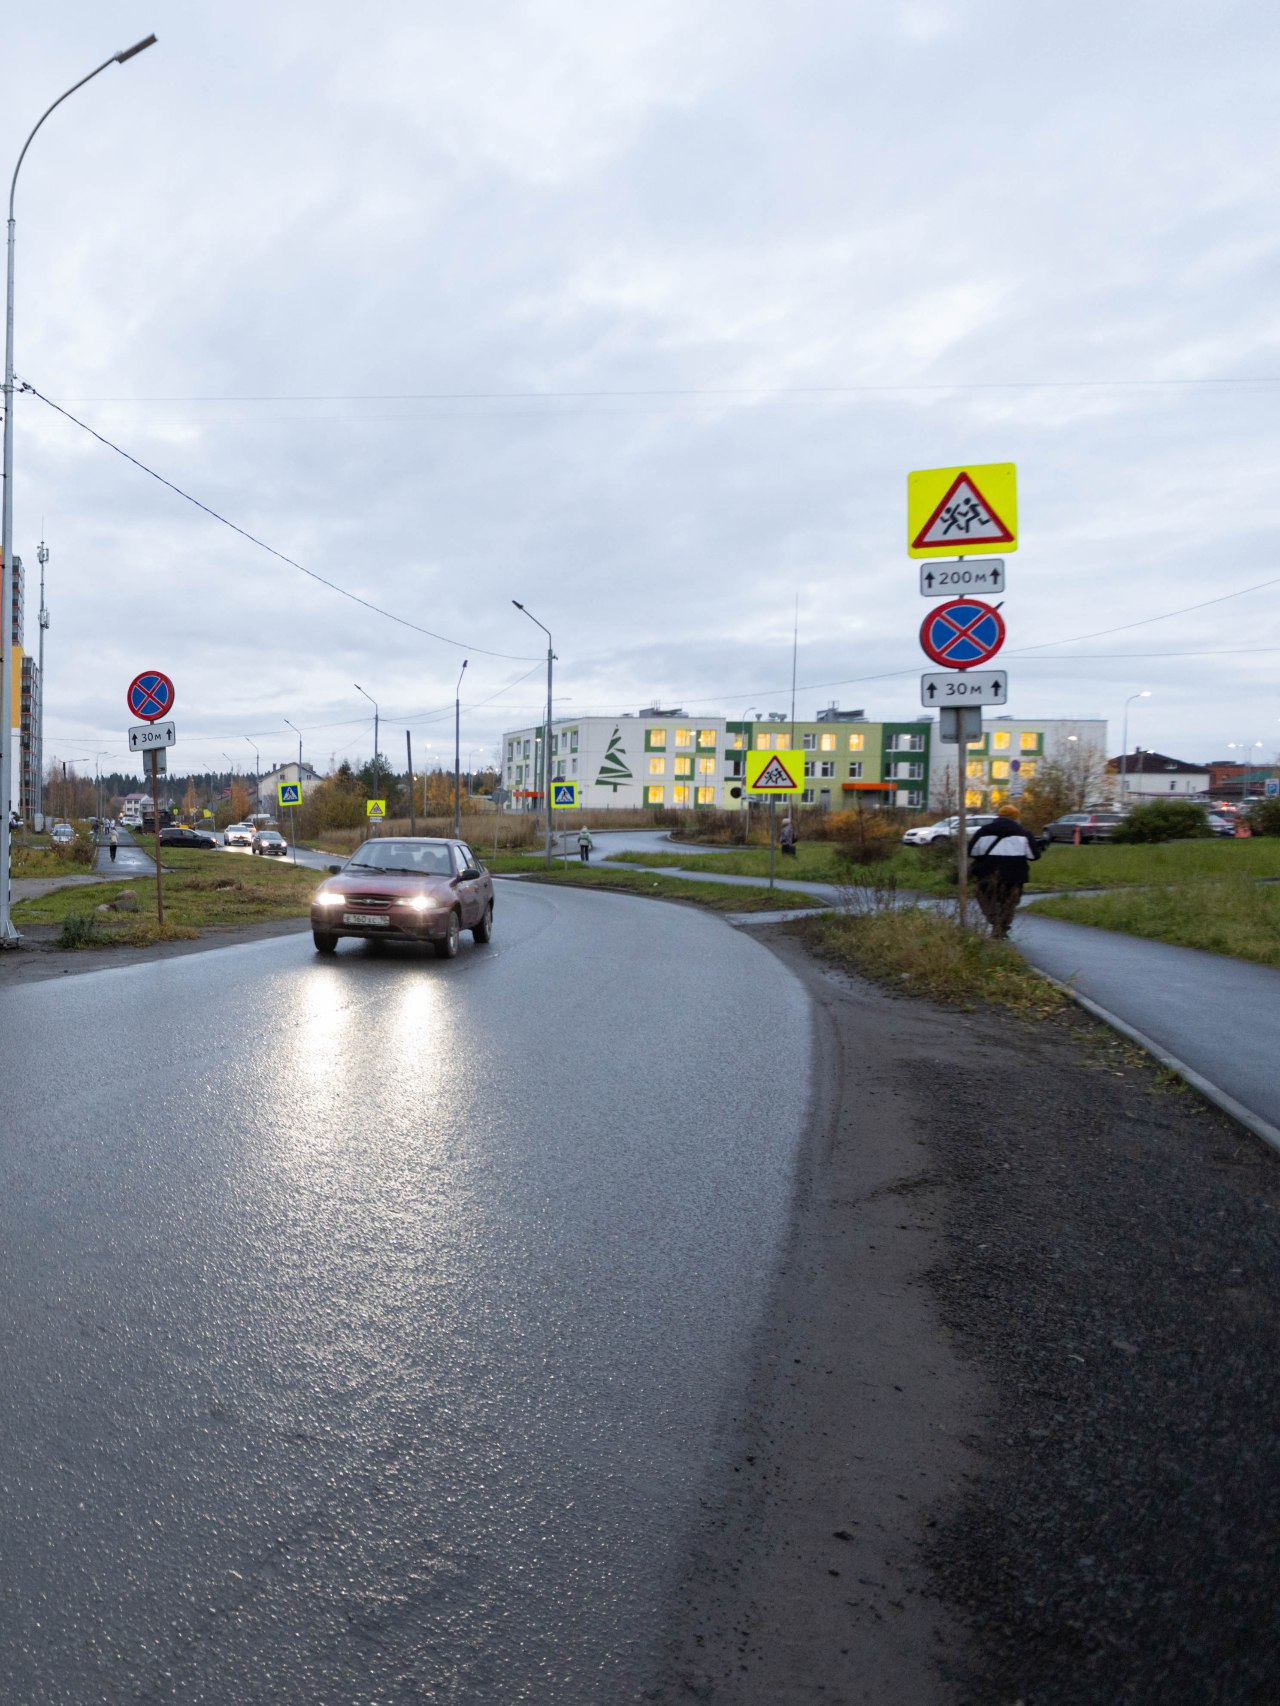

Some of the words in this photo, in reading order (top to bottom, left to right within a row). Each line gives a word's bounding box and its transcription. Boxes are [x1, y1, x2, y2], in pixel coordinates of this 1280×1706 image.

[939, 571, 987, 585] 200м
[945, 683, 982, 696] 30м
[141, 732, 162, 743] 30м
